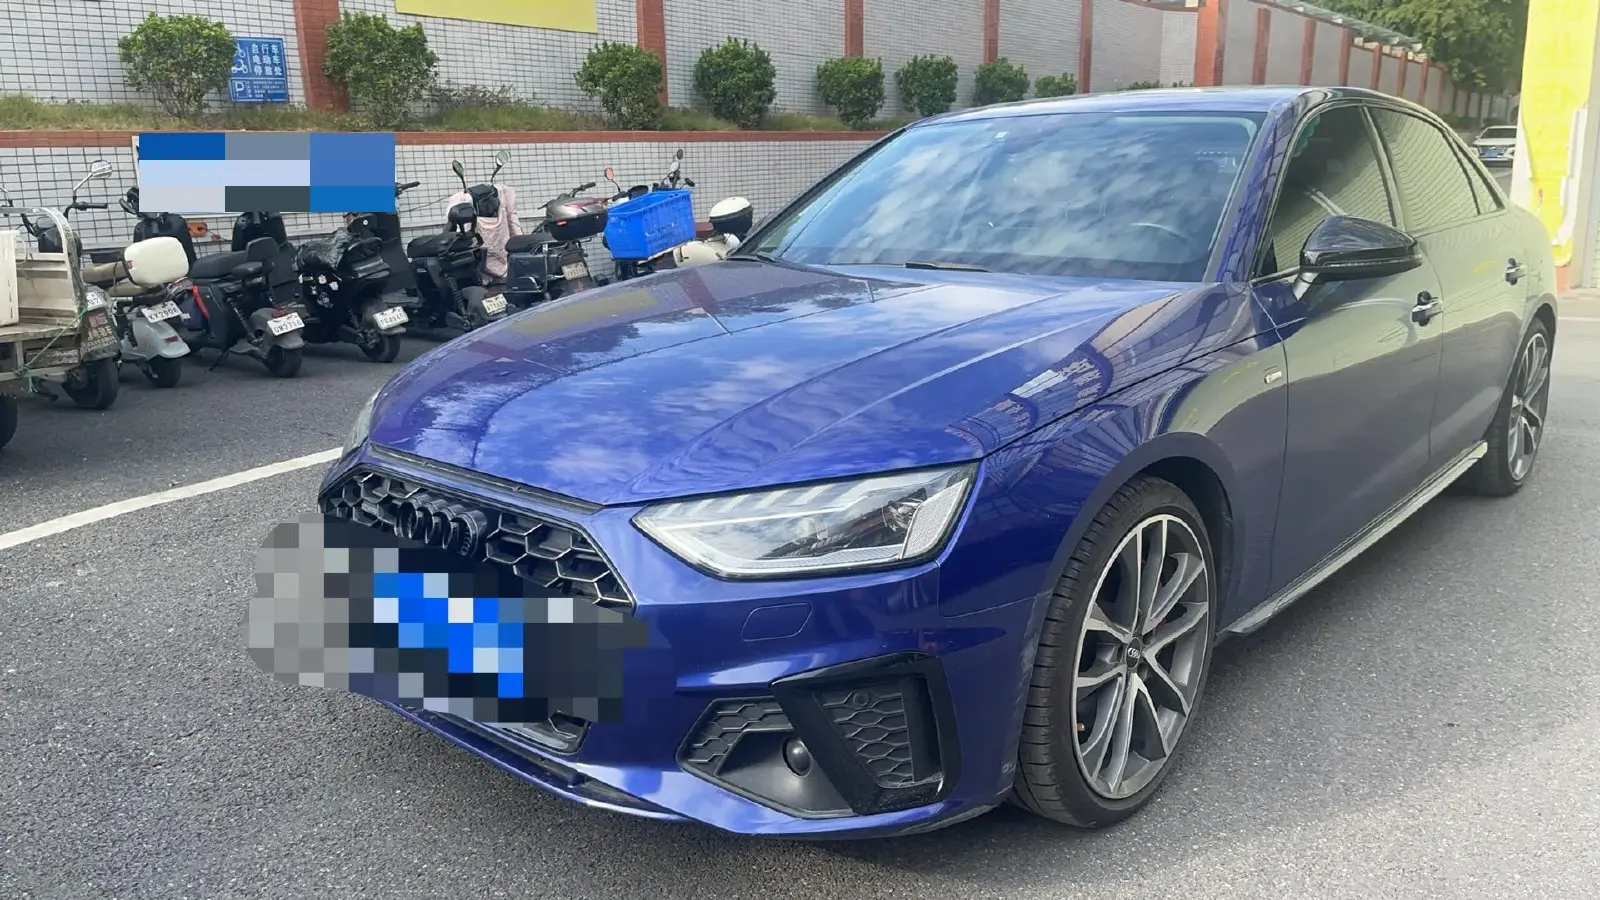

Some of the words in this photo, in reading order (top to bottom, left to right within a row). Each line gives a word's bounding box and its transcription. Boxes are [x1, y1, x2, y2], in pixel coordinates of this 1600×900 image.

[251, 43, 280, 54] 自行车
[252, 54, 281, 65] 电动车
[254, 65, 283, 76] 停放处
